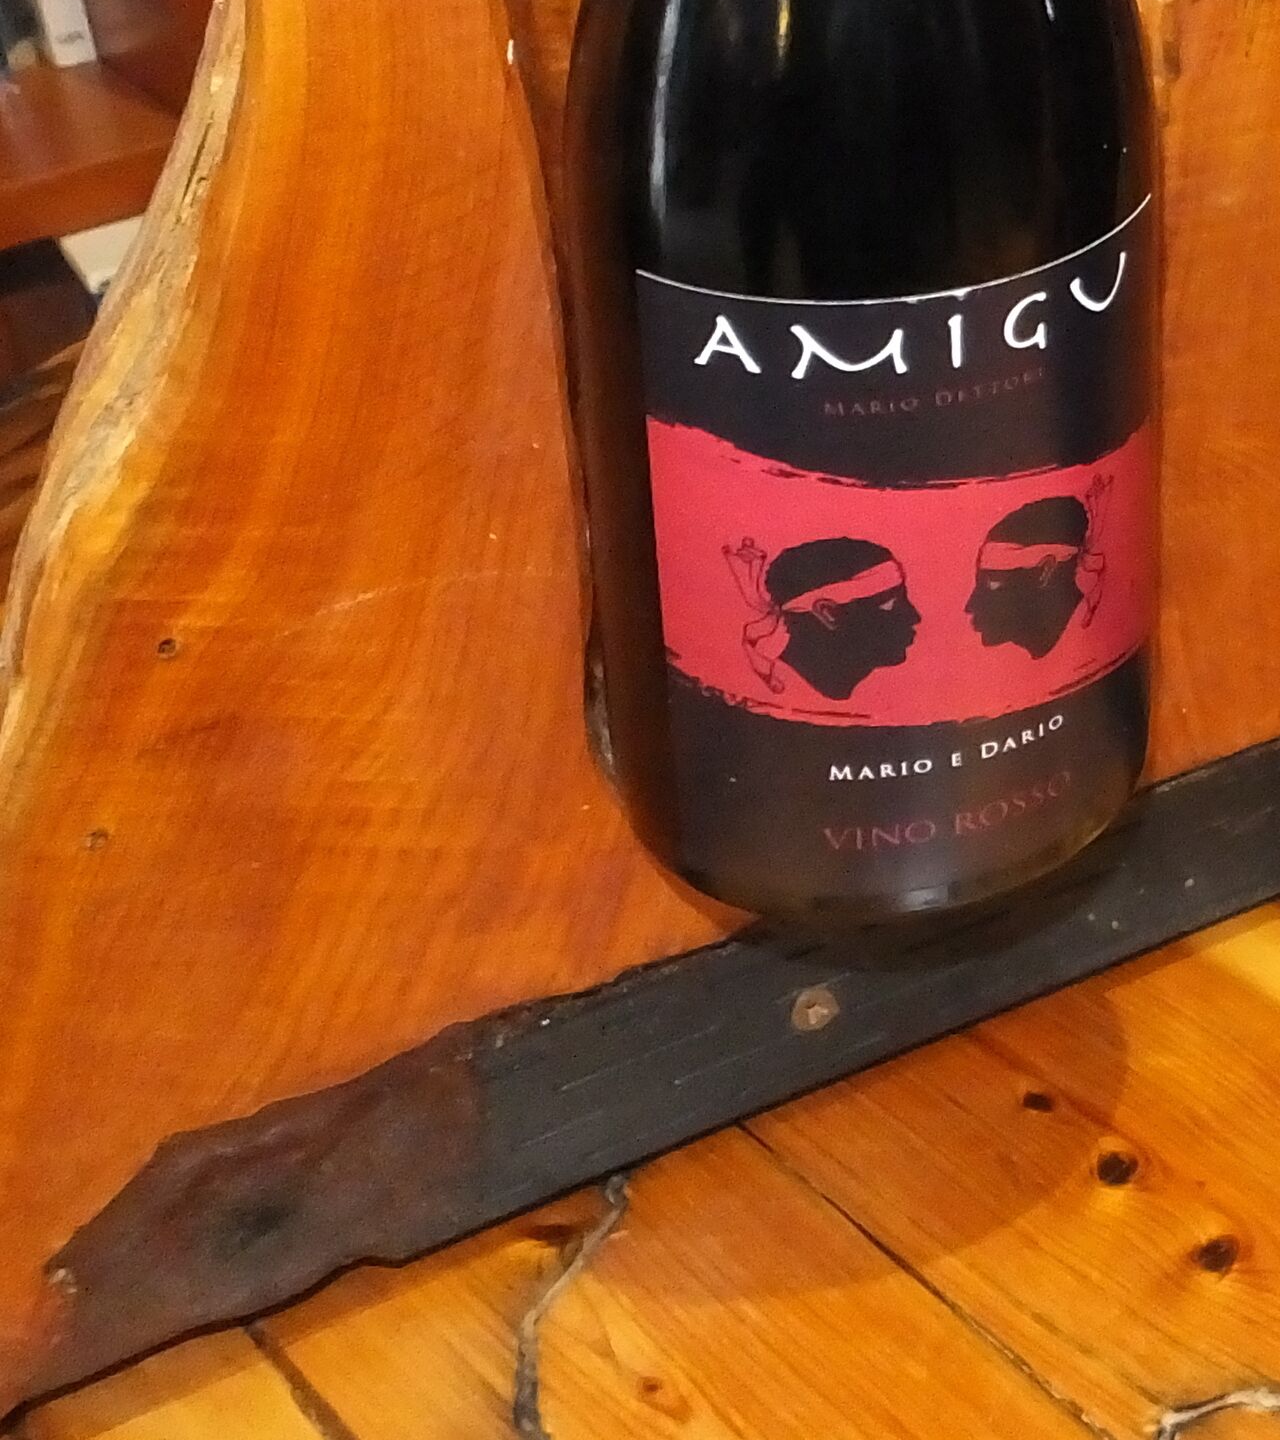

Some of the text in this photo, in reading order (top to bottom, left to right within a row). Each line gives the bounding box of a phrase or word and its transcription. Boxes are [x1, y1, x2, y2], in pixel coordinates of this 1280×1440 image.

[693, 250, 1128, 380] AMIGU
[828, 713, 1066, 782] MARIO E DARIO
[822, 769, 1073, 852] VINO ROSSO
